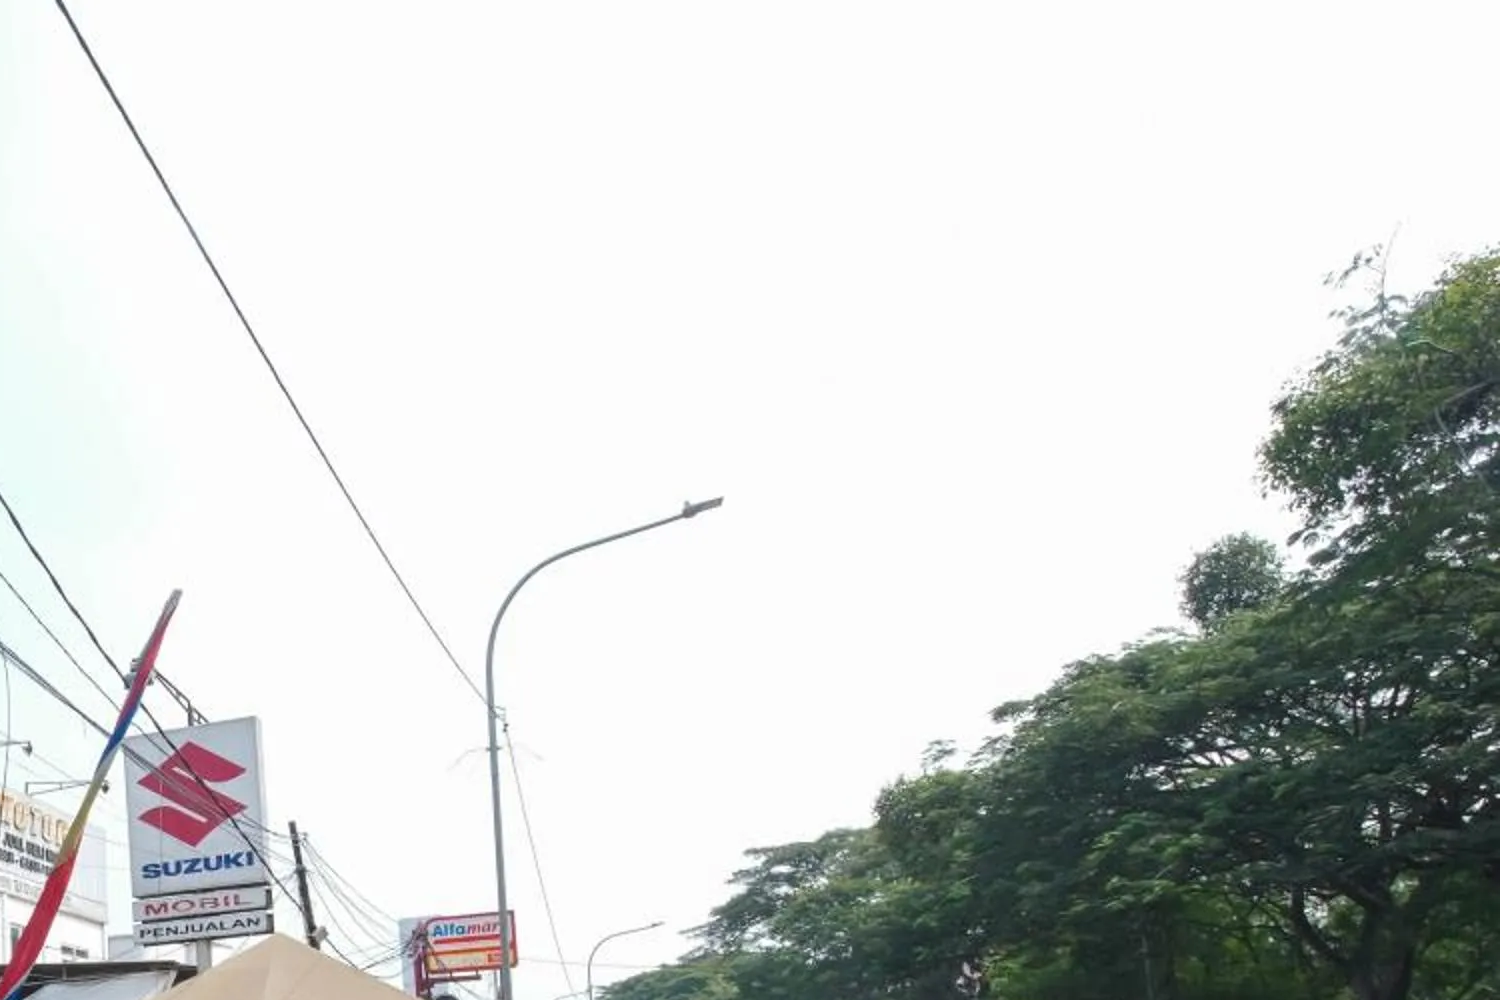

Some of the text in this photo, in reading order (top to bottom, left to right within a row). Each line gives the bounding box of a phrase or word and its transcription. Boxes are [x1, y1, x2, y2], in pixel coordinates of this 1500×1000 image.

[142, 851, 254, 879] SUZUKI
[144, 893, 250, 917] MOBIL
[139, 917, 260, 938] PENJUALAN
